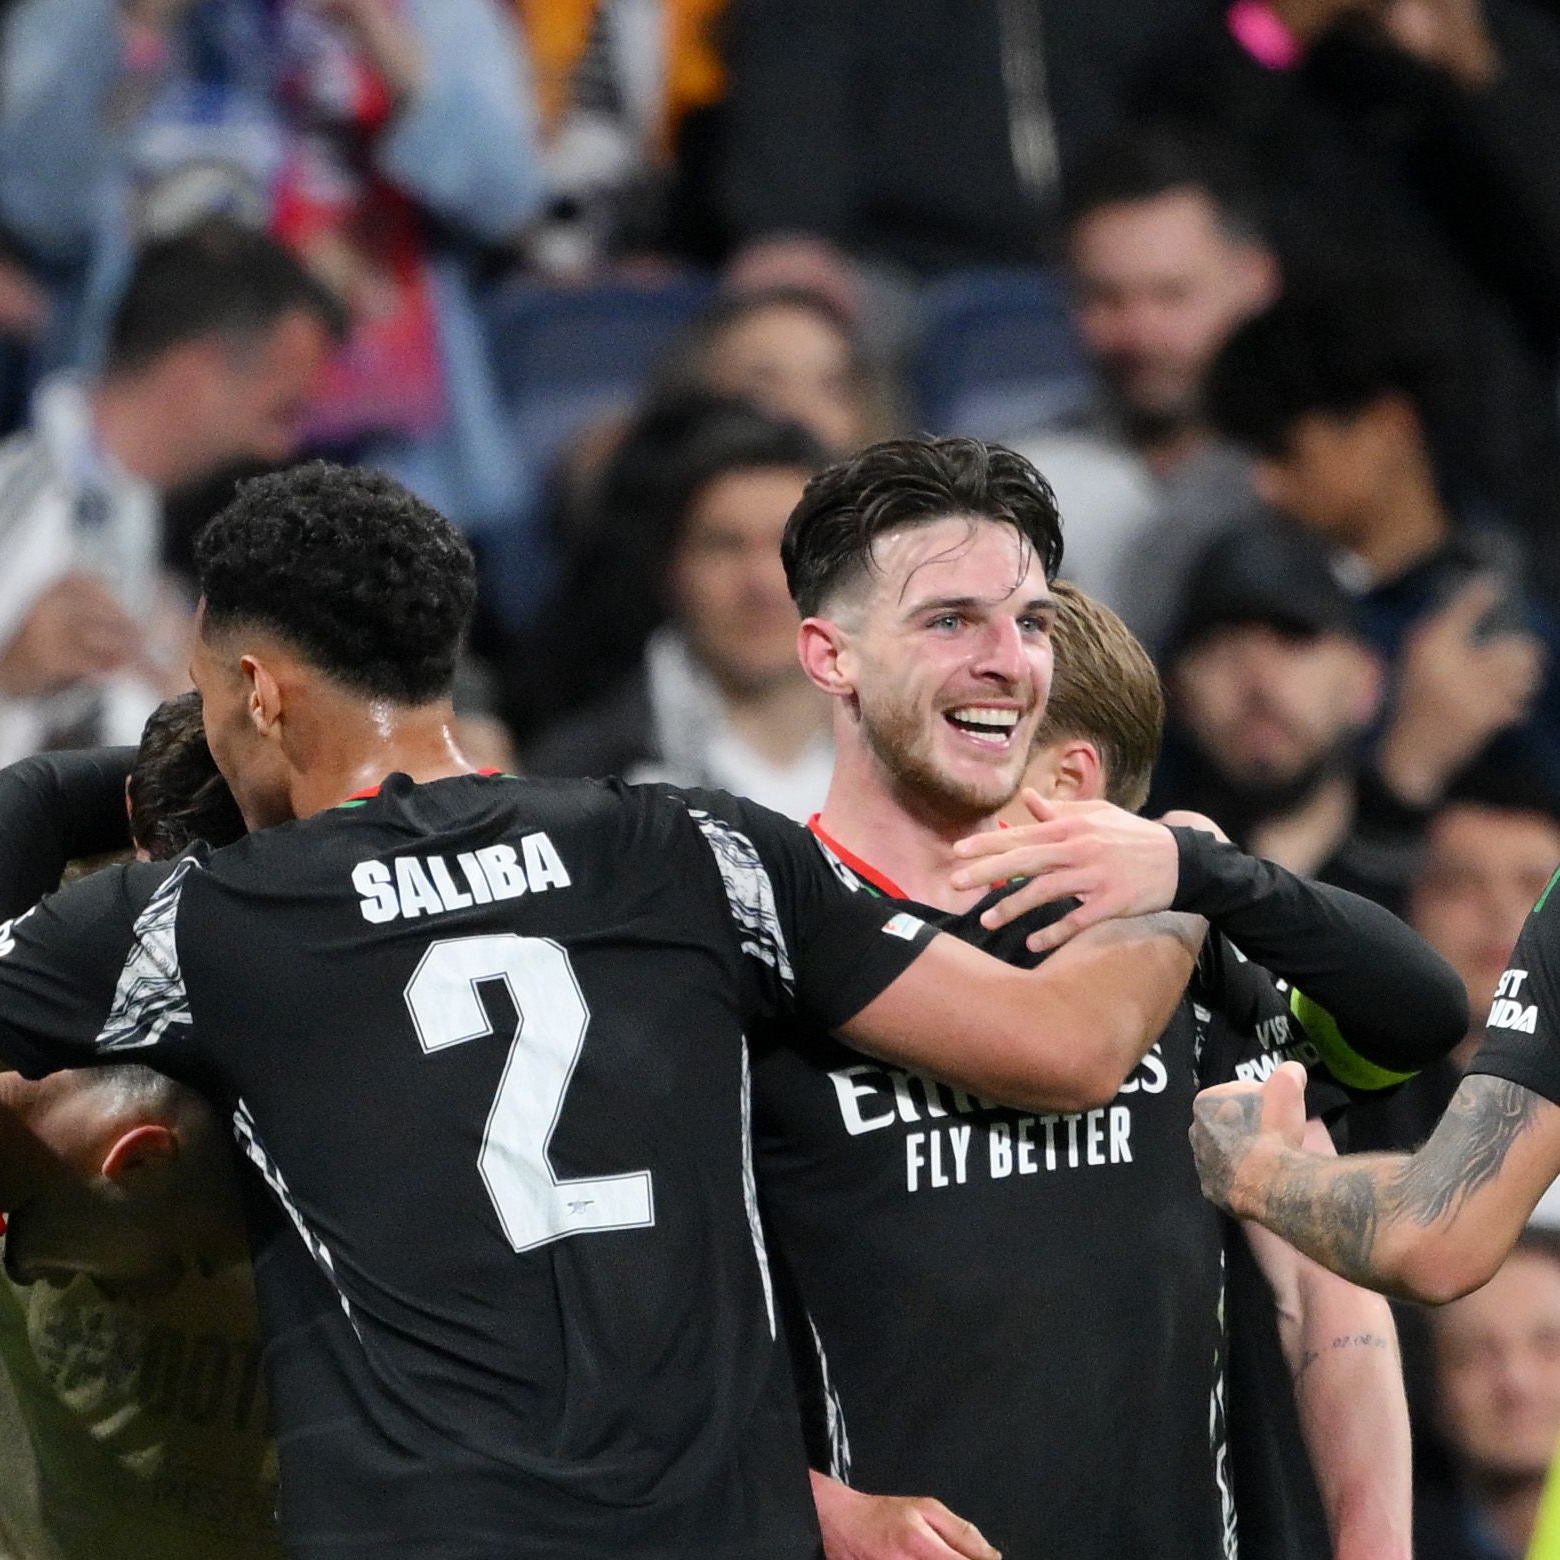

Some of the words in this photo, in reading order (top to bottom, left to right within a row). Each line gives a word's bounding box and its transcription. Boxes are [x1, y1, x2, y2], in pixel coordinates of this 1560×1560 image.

[352, 831, 572, 925] SALIBA
[403, 933, 655, 1254] 2
[906, 1125, 971, 1192] FLY
[990, 1105, 1134, 1179] BETTER
